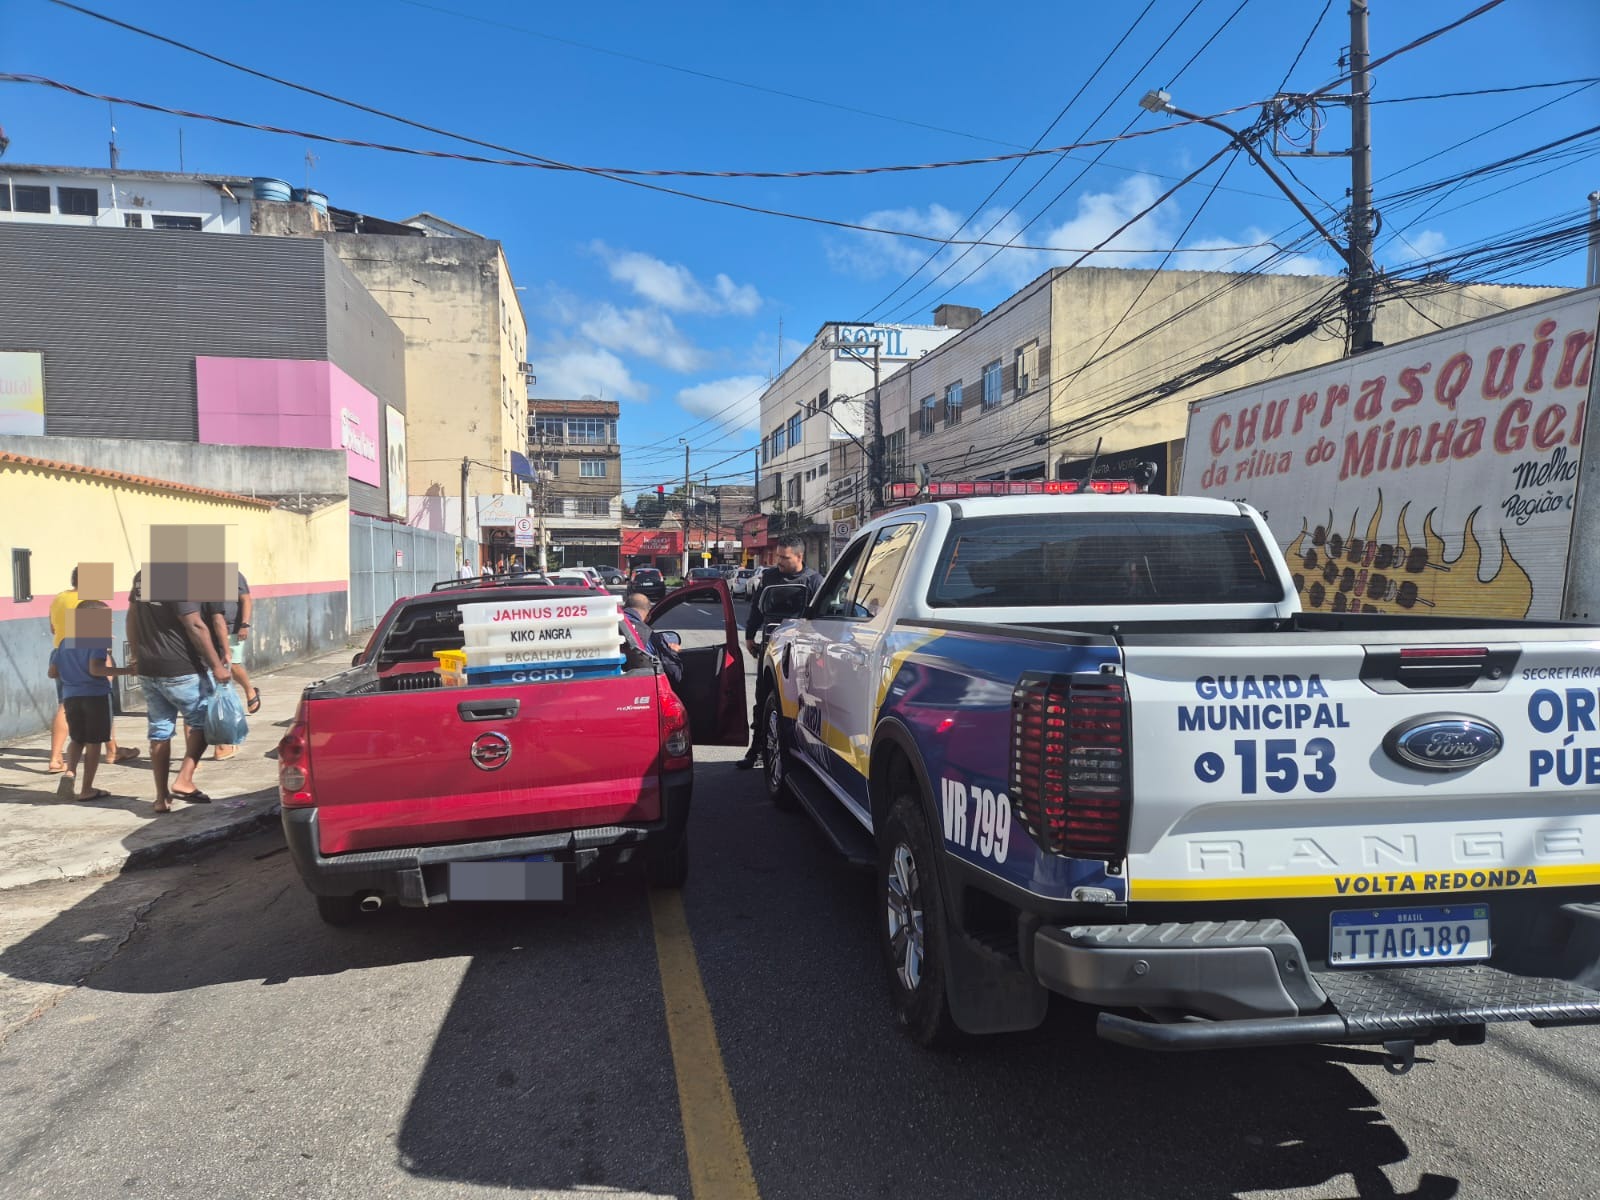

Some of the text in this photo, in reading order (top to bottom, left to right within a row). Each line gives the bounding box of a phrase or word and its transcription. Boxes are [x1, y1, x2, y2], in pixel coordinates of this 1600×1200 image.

[841, 327, 908, 356] SOTIL
[1201, 458, 1229, 490] da
[1305, 436, 1336, 466] do
[493, 605, 588, 621] JAHNUS 2025
[511, 628, 572, 642] KIKO ANGRA
[505, 649, 572, 663] BACALHAU
[512, 668, 575, 682] GCRD
[1195, 674, 1328, 700] GUARDA
[1178, 703, 1350, 731] MUNICIPAL
[1234, 737, 1337, 794] 153
[940, 777, 1011, 864] VR 799
[1186, 827, 1584, 872] RANGE
[1334, 869, 1538, 894] VOLTA REDONDA
[1397, 914, 1423, 922] BRASIL
